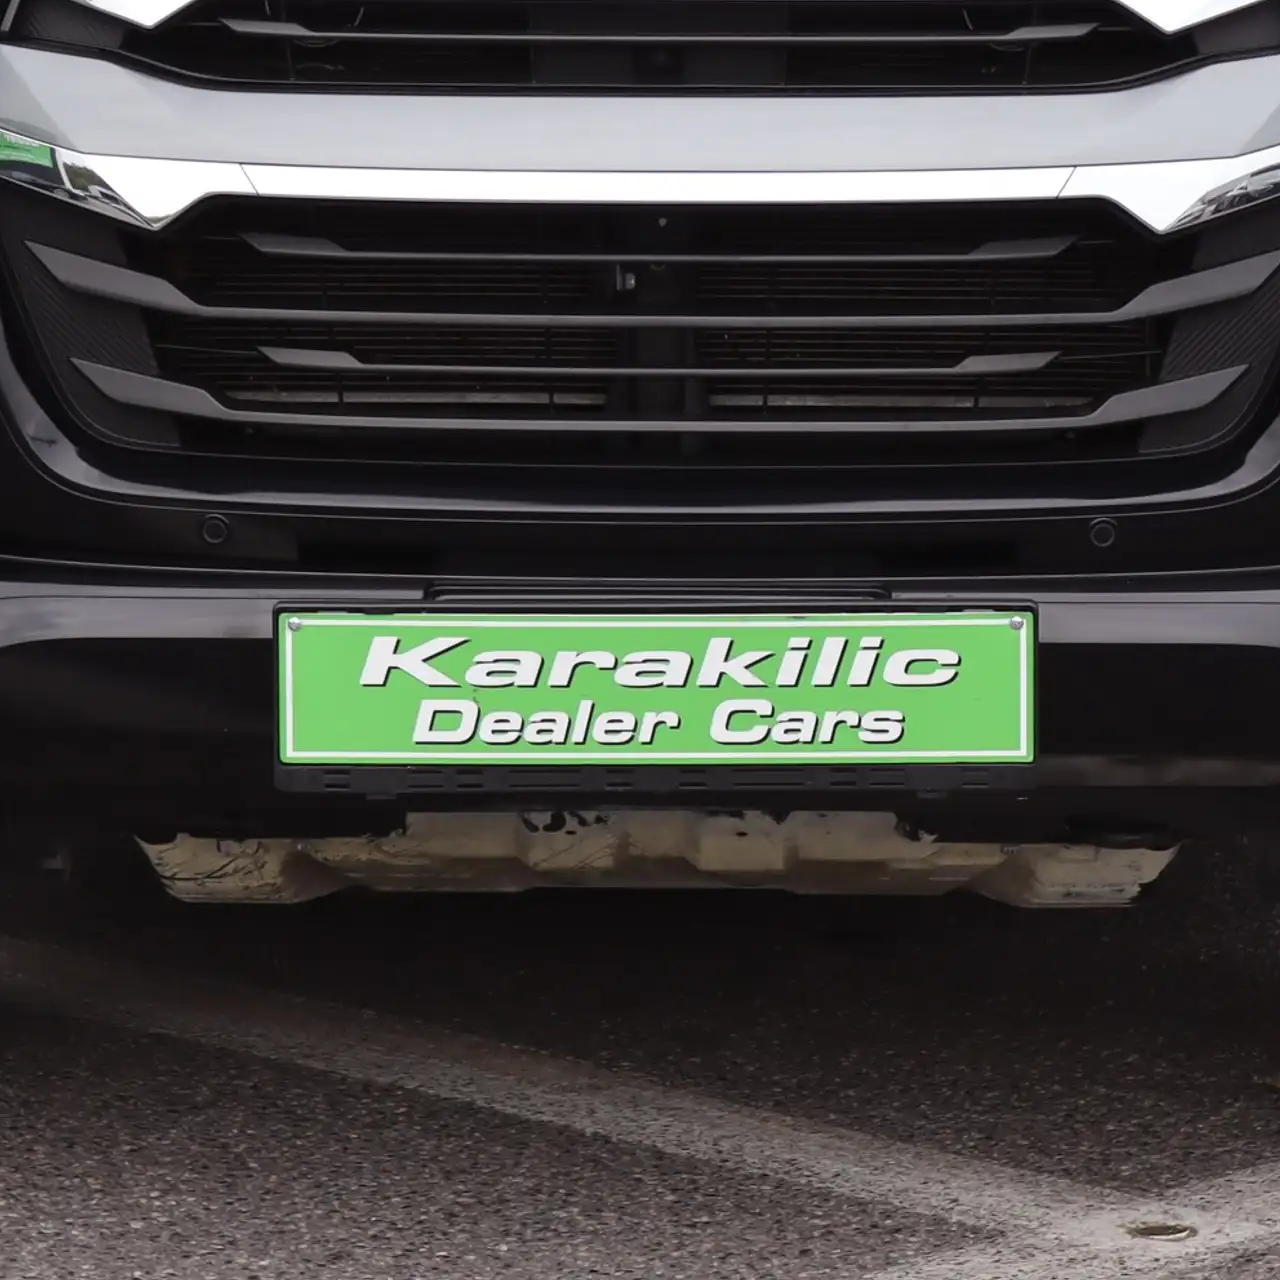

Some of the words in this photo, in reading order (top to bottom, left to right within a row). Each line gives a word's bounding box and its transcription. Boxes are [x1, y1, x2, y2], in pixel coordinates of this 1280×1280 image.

[358, 635, 962, 689] Karakilic
[411, 698, 682, 745] Dealer
[707, 697, 905, 744] Cars
